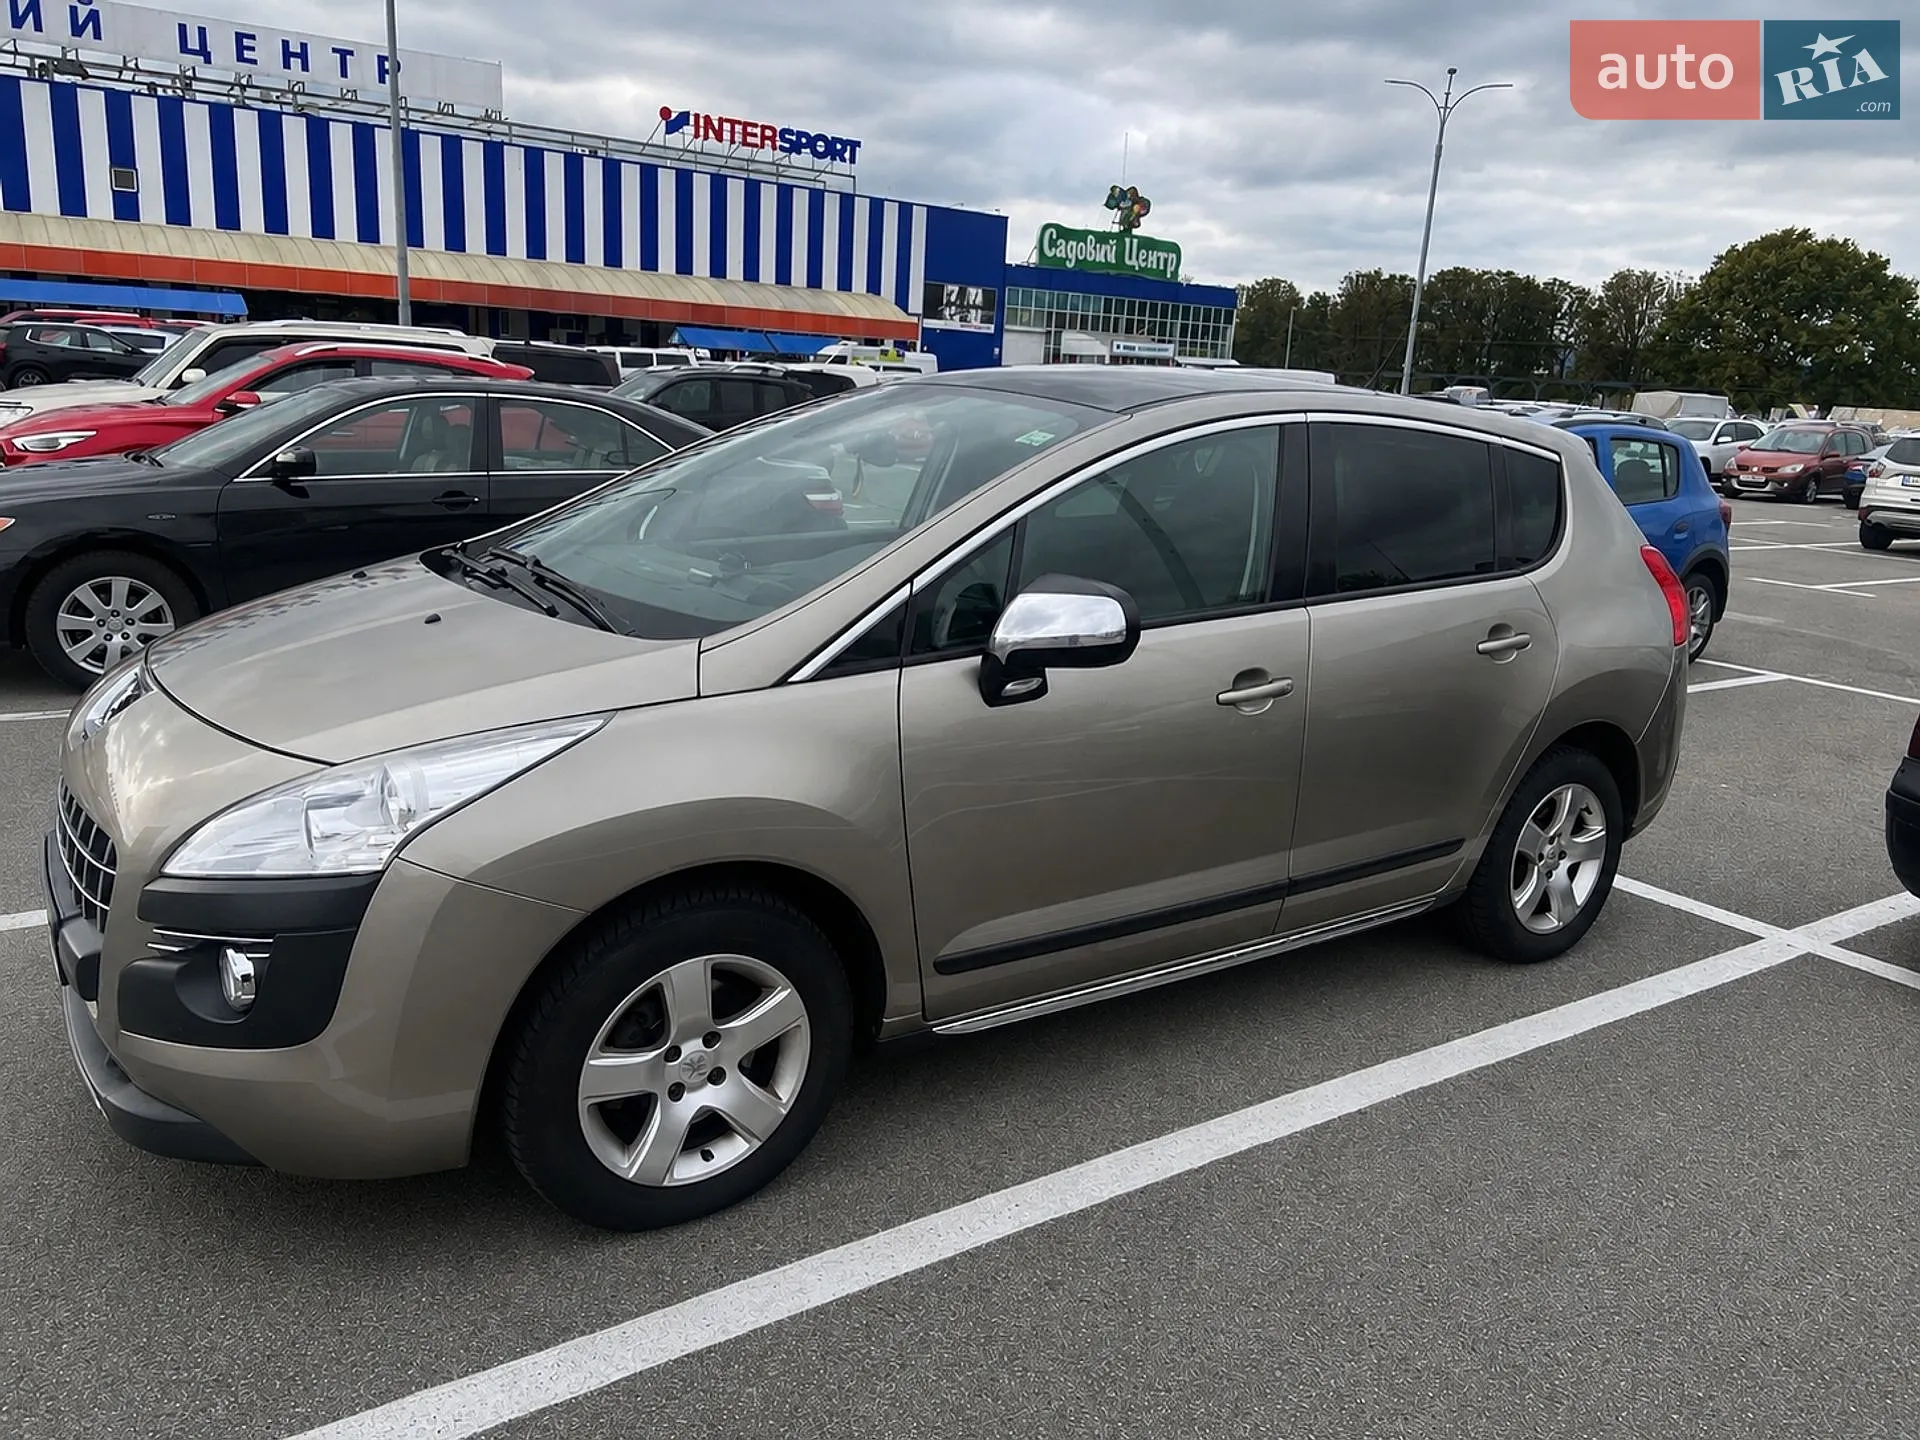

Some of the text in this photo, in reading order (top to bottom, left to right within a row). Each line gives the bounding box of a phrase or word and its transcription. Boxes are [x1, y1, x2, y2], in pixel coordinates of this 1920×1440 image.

[177, 22, 402, 85] ЦЕНТР
[693, 112, 862, 164] INTERSPORT
[1043, 227, 1177, 278] Садовий Центр
